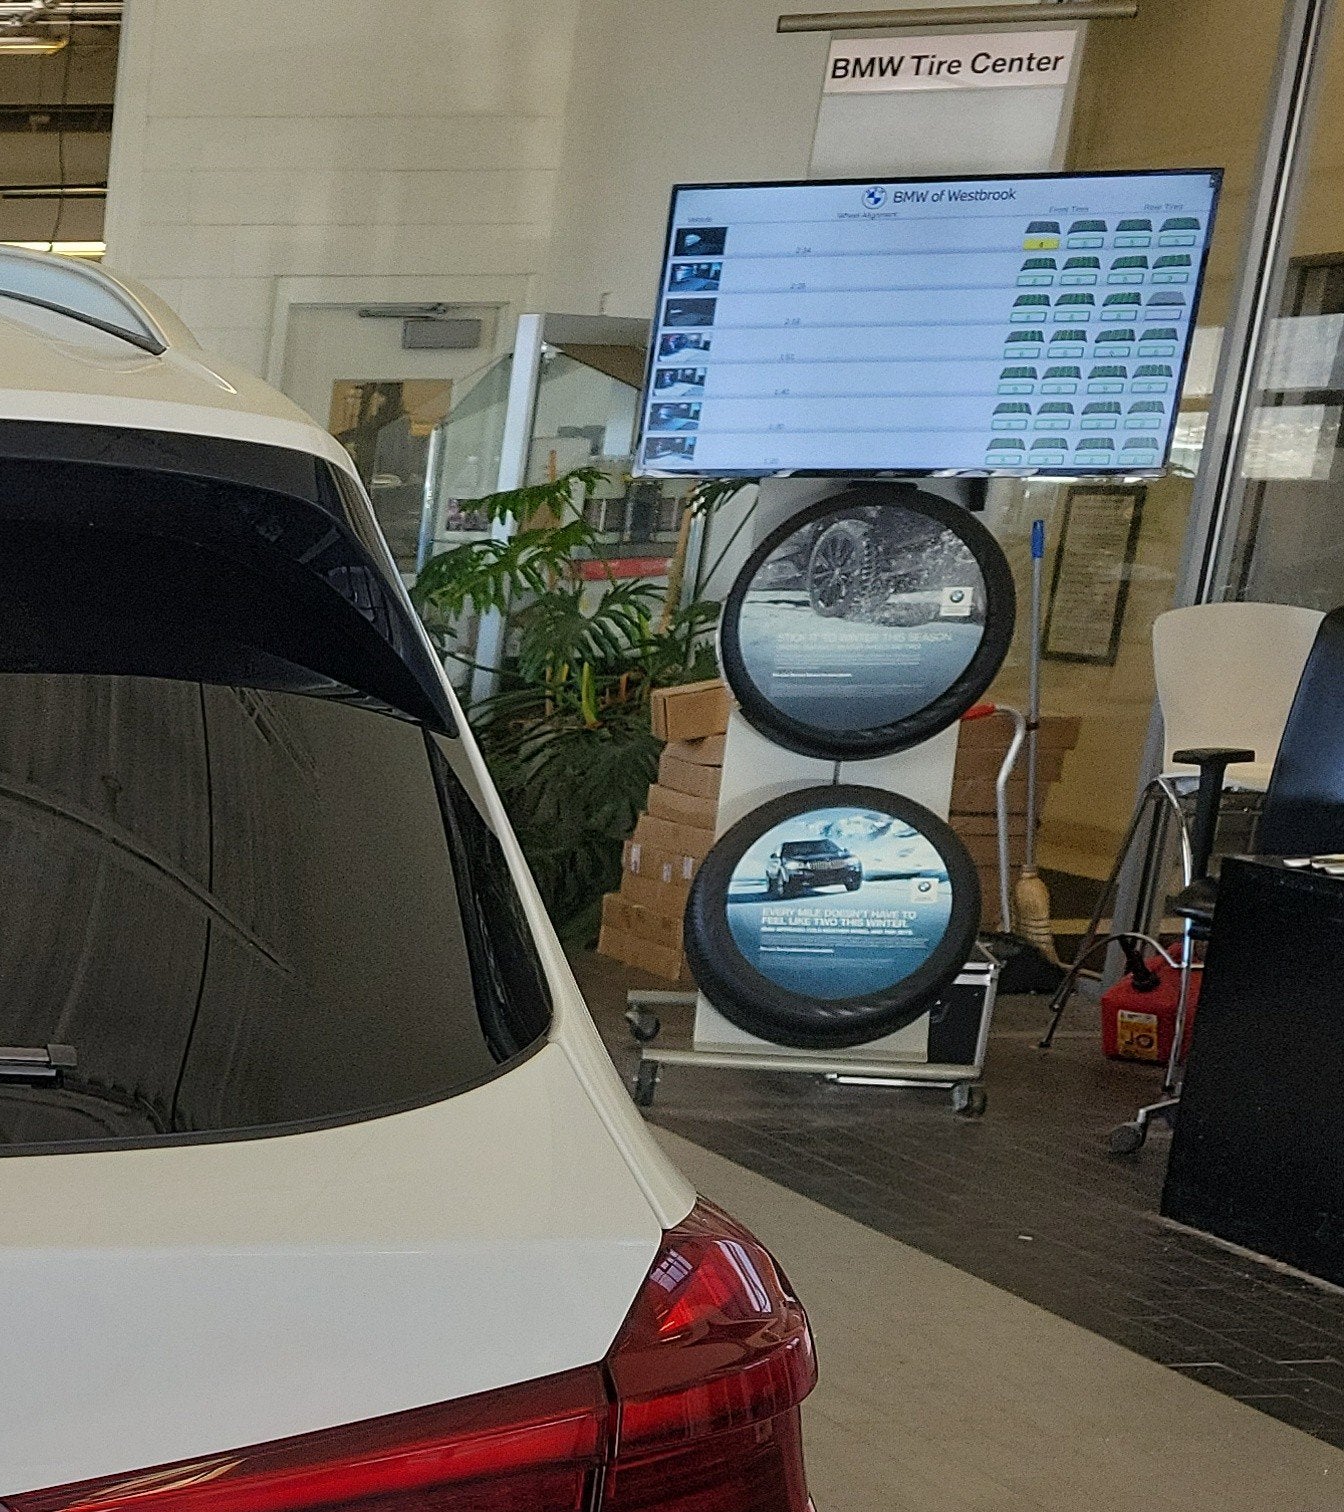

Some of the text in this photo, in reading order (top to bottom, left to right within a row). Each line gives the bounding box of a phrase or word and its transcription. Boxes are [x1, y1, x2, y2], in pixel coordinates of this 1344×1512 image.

[830, 51, 1065, 79] BMW Tire Center
[892, 188, 1017, 203] BMW of Westbrook
